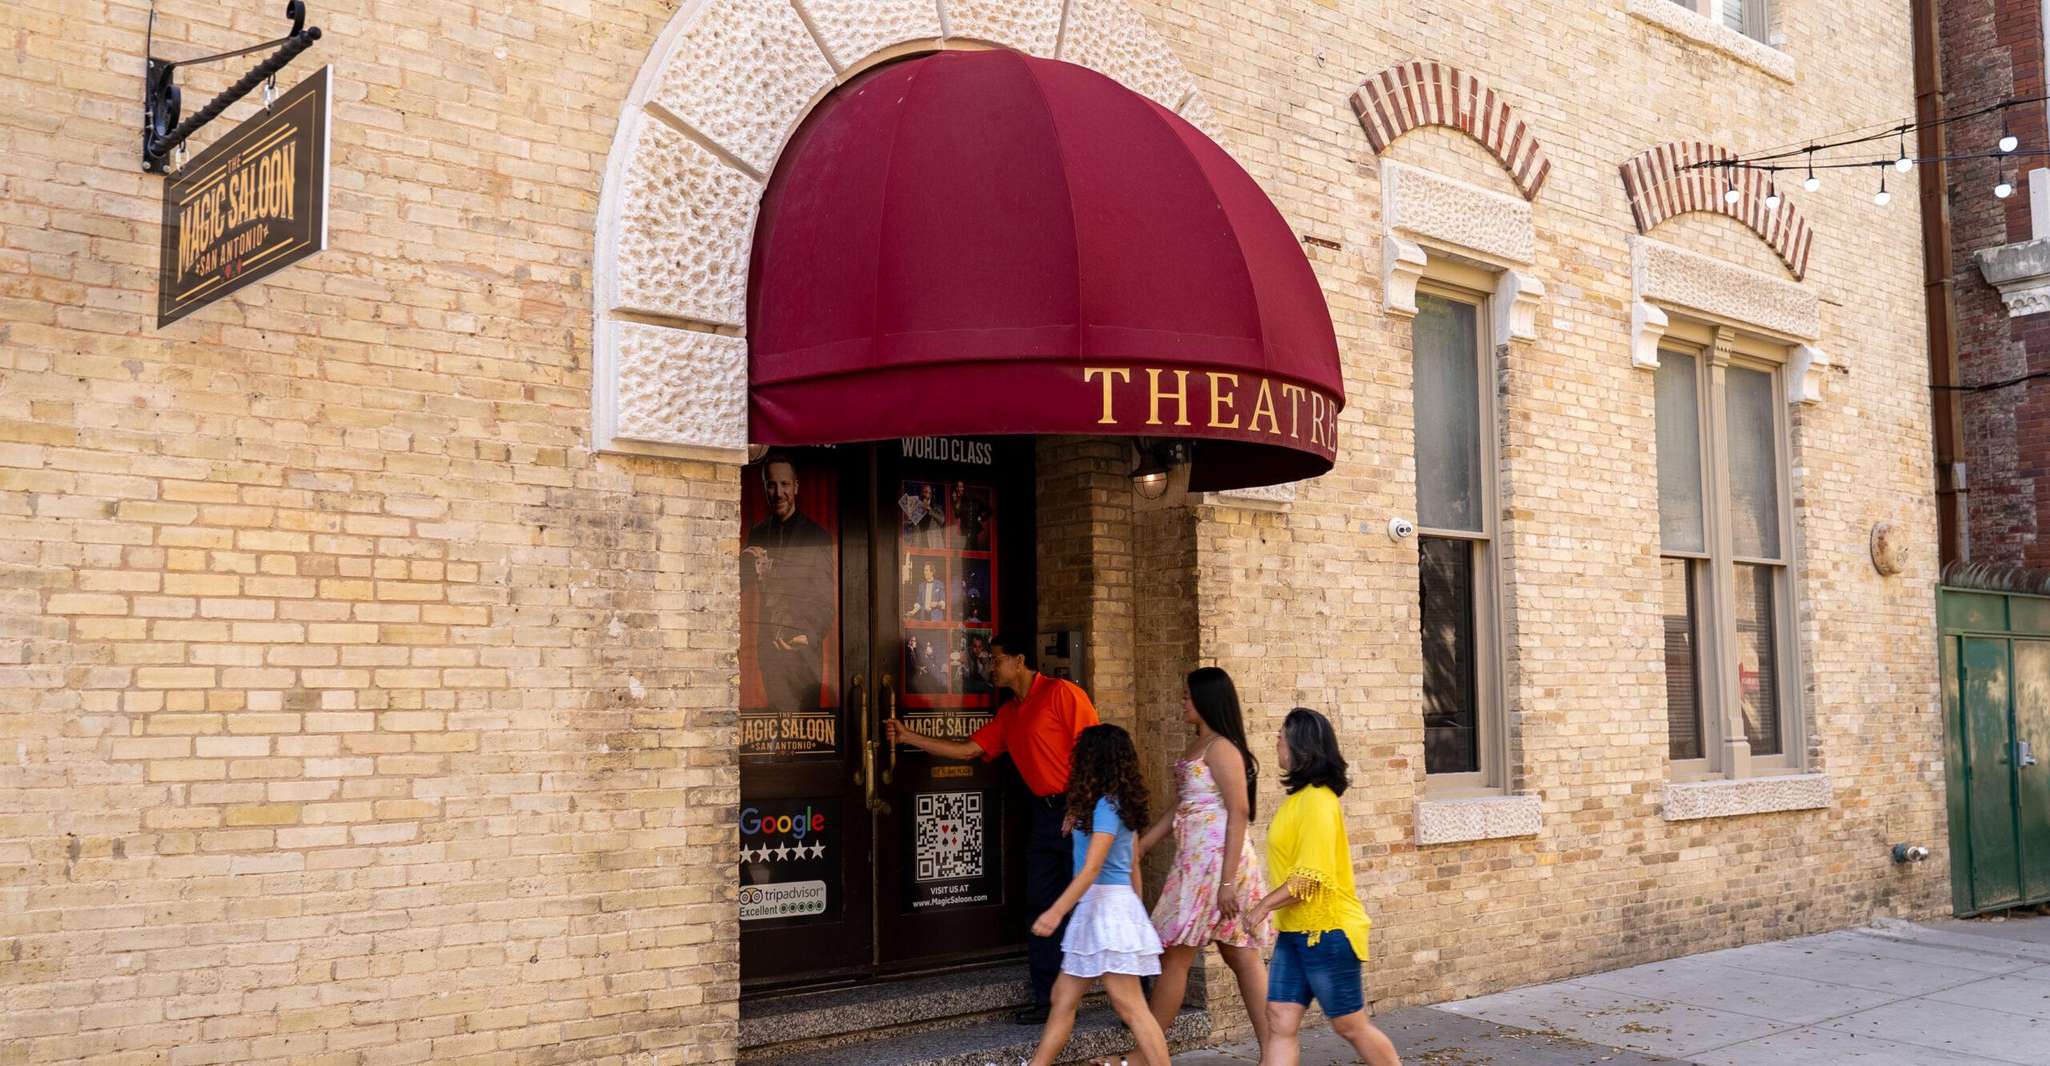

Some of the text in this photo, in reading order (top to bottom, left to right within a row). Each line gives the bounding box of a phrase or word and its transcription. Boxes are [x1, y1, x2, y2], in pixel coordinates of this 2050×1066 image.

[227, 153, 241, 174] THE
[176, 141, 297, 284] MAGIC SALOON
[200, 225, 263, 277] SAN ANTONIO
[1084, 367, 1337, 452] THEATRE
[902, 436, 993, 465] WORLD CLASS
[781, 718, 836, 746] SALOON
[946, 717, 994, 737] SALO
[755, 740, 812, 751] SAN ANTONIO
[740, 805, 825, 839] Google
[912, 894, 988, 908] www.MagicSaloon.com
[930, 884, 969, 895] VISIT US AT
[739, 904, 778, 918] Excellent
